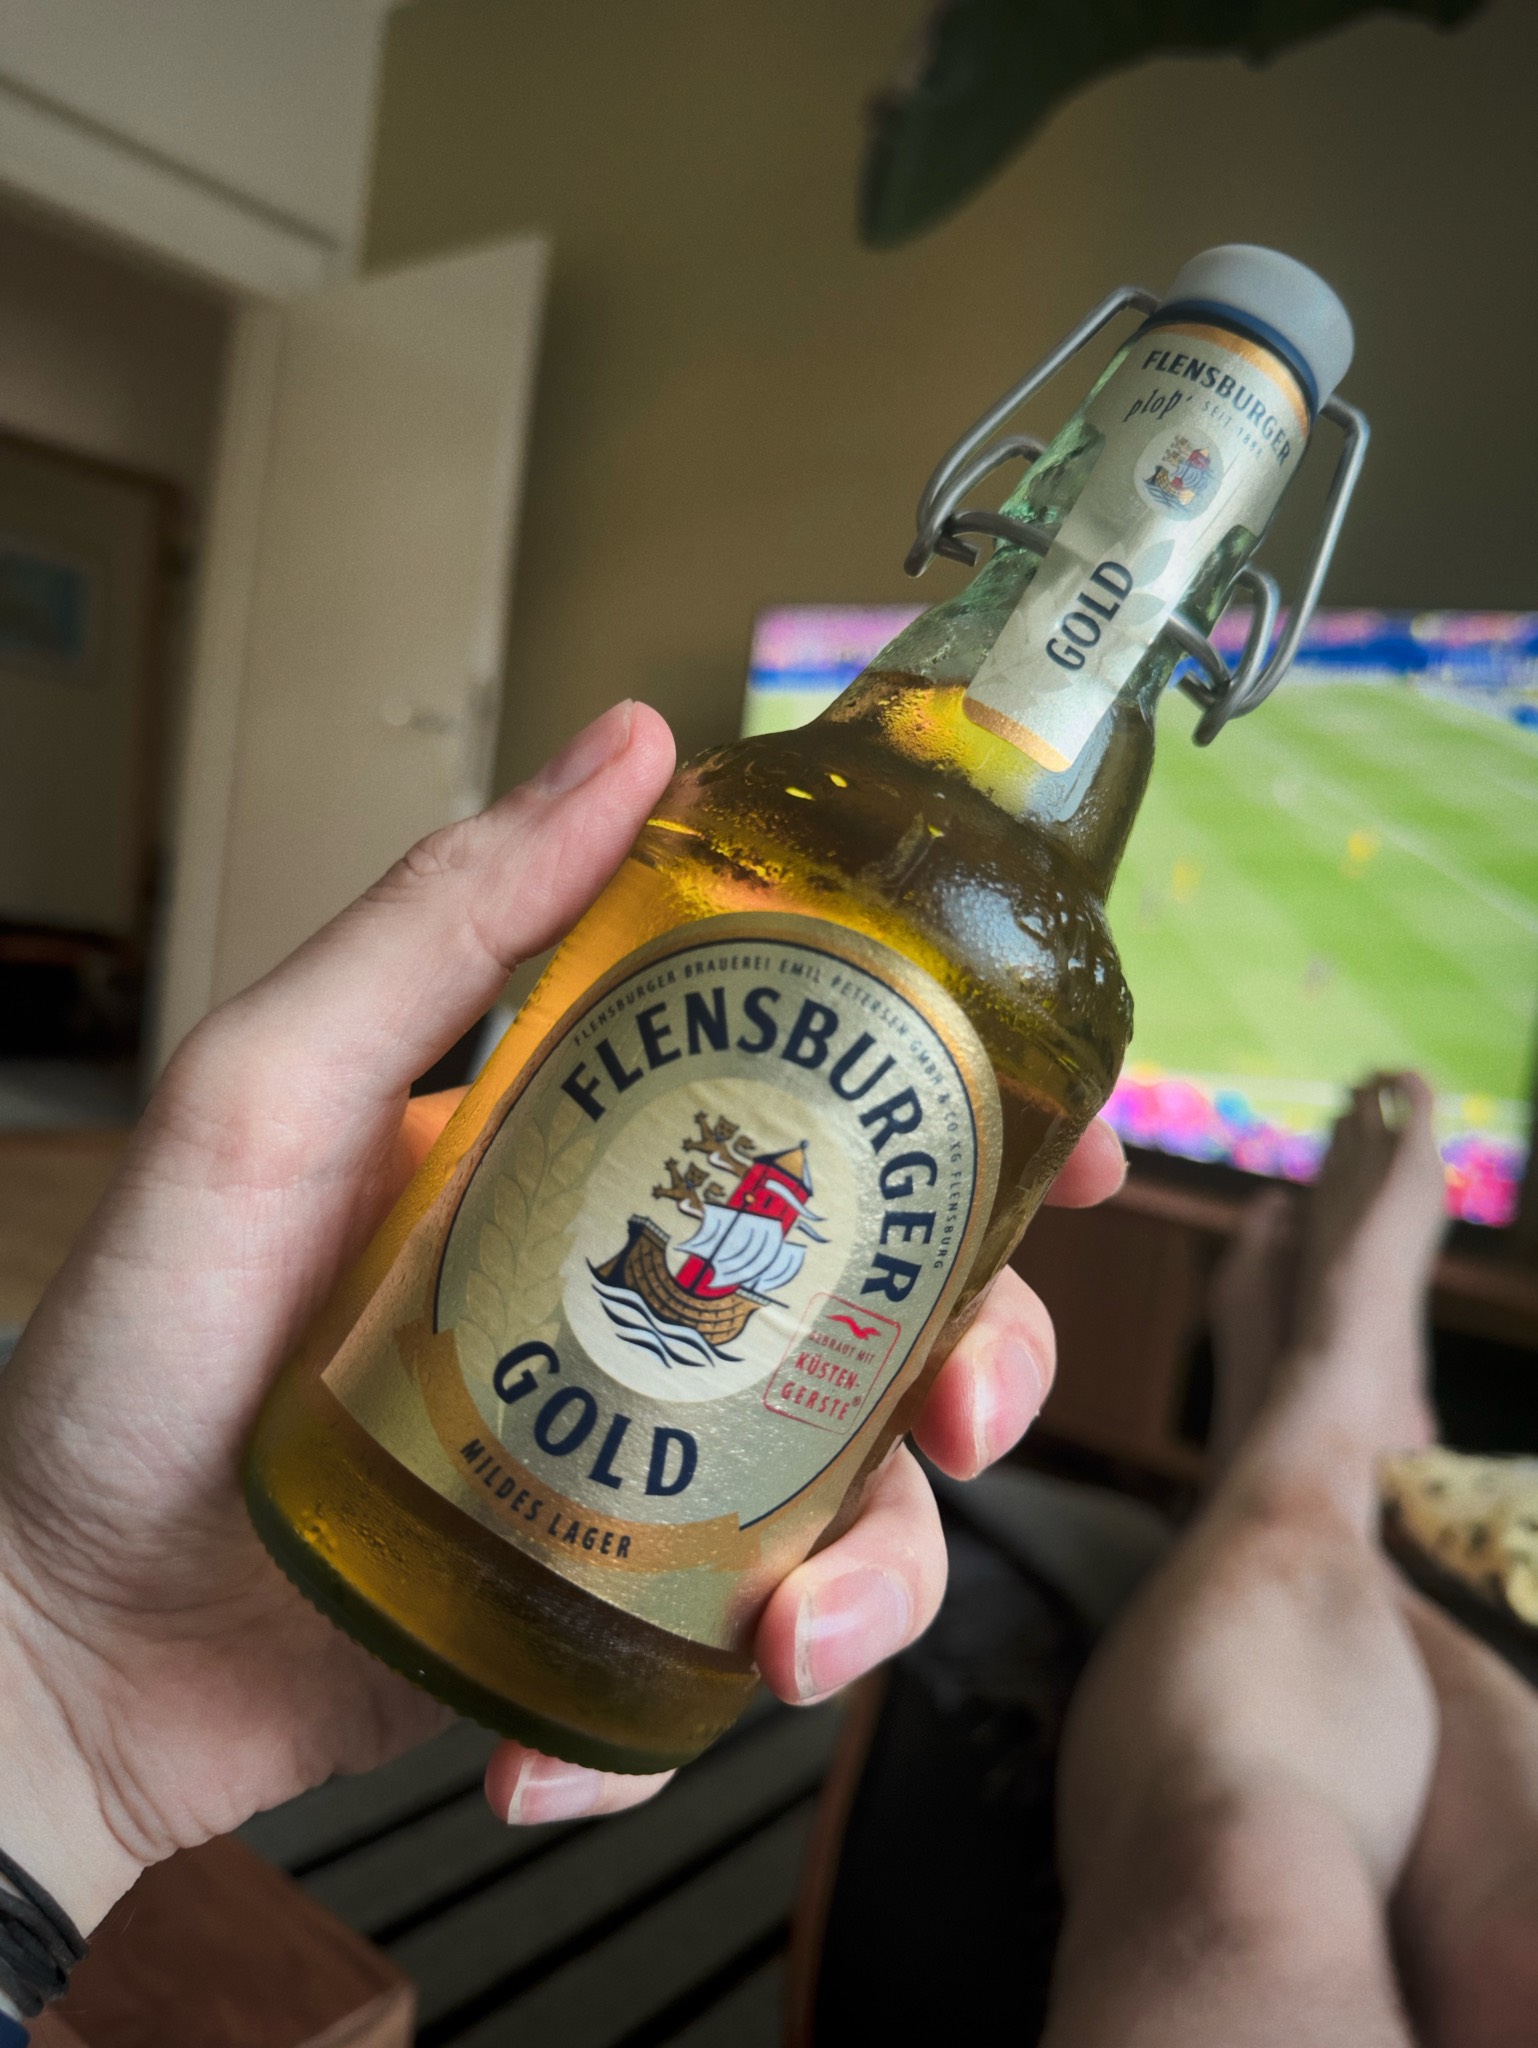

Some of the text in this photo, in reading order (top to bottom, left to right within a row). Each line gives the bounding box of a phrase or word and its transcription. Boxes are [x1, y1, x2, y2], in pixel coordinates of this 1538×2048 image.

[1142, 350, 1291, 466] FLENSBURGER
[1045, 561, 1134, 671] GOLD
[560, 986, 938, 1303] FLENSBURGER
[573, 971, 677, 1046] FLENSBURGER
[685, 956, 771, 978] BRAUEREI
[779, 959, 821, 983] EMIL
[933, 1171, 962, 1270] FLENSBURG
[794, 1351, 861, 1390] KÜSTEN-
[808, 1330, 876, 1366] GEBRAUT MIT
[493, 1340, 698, 1496] GOLD
[460, 1438, 632, 1558] MILDES LAGER
